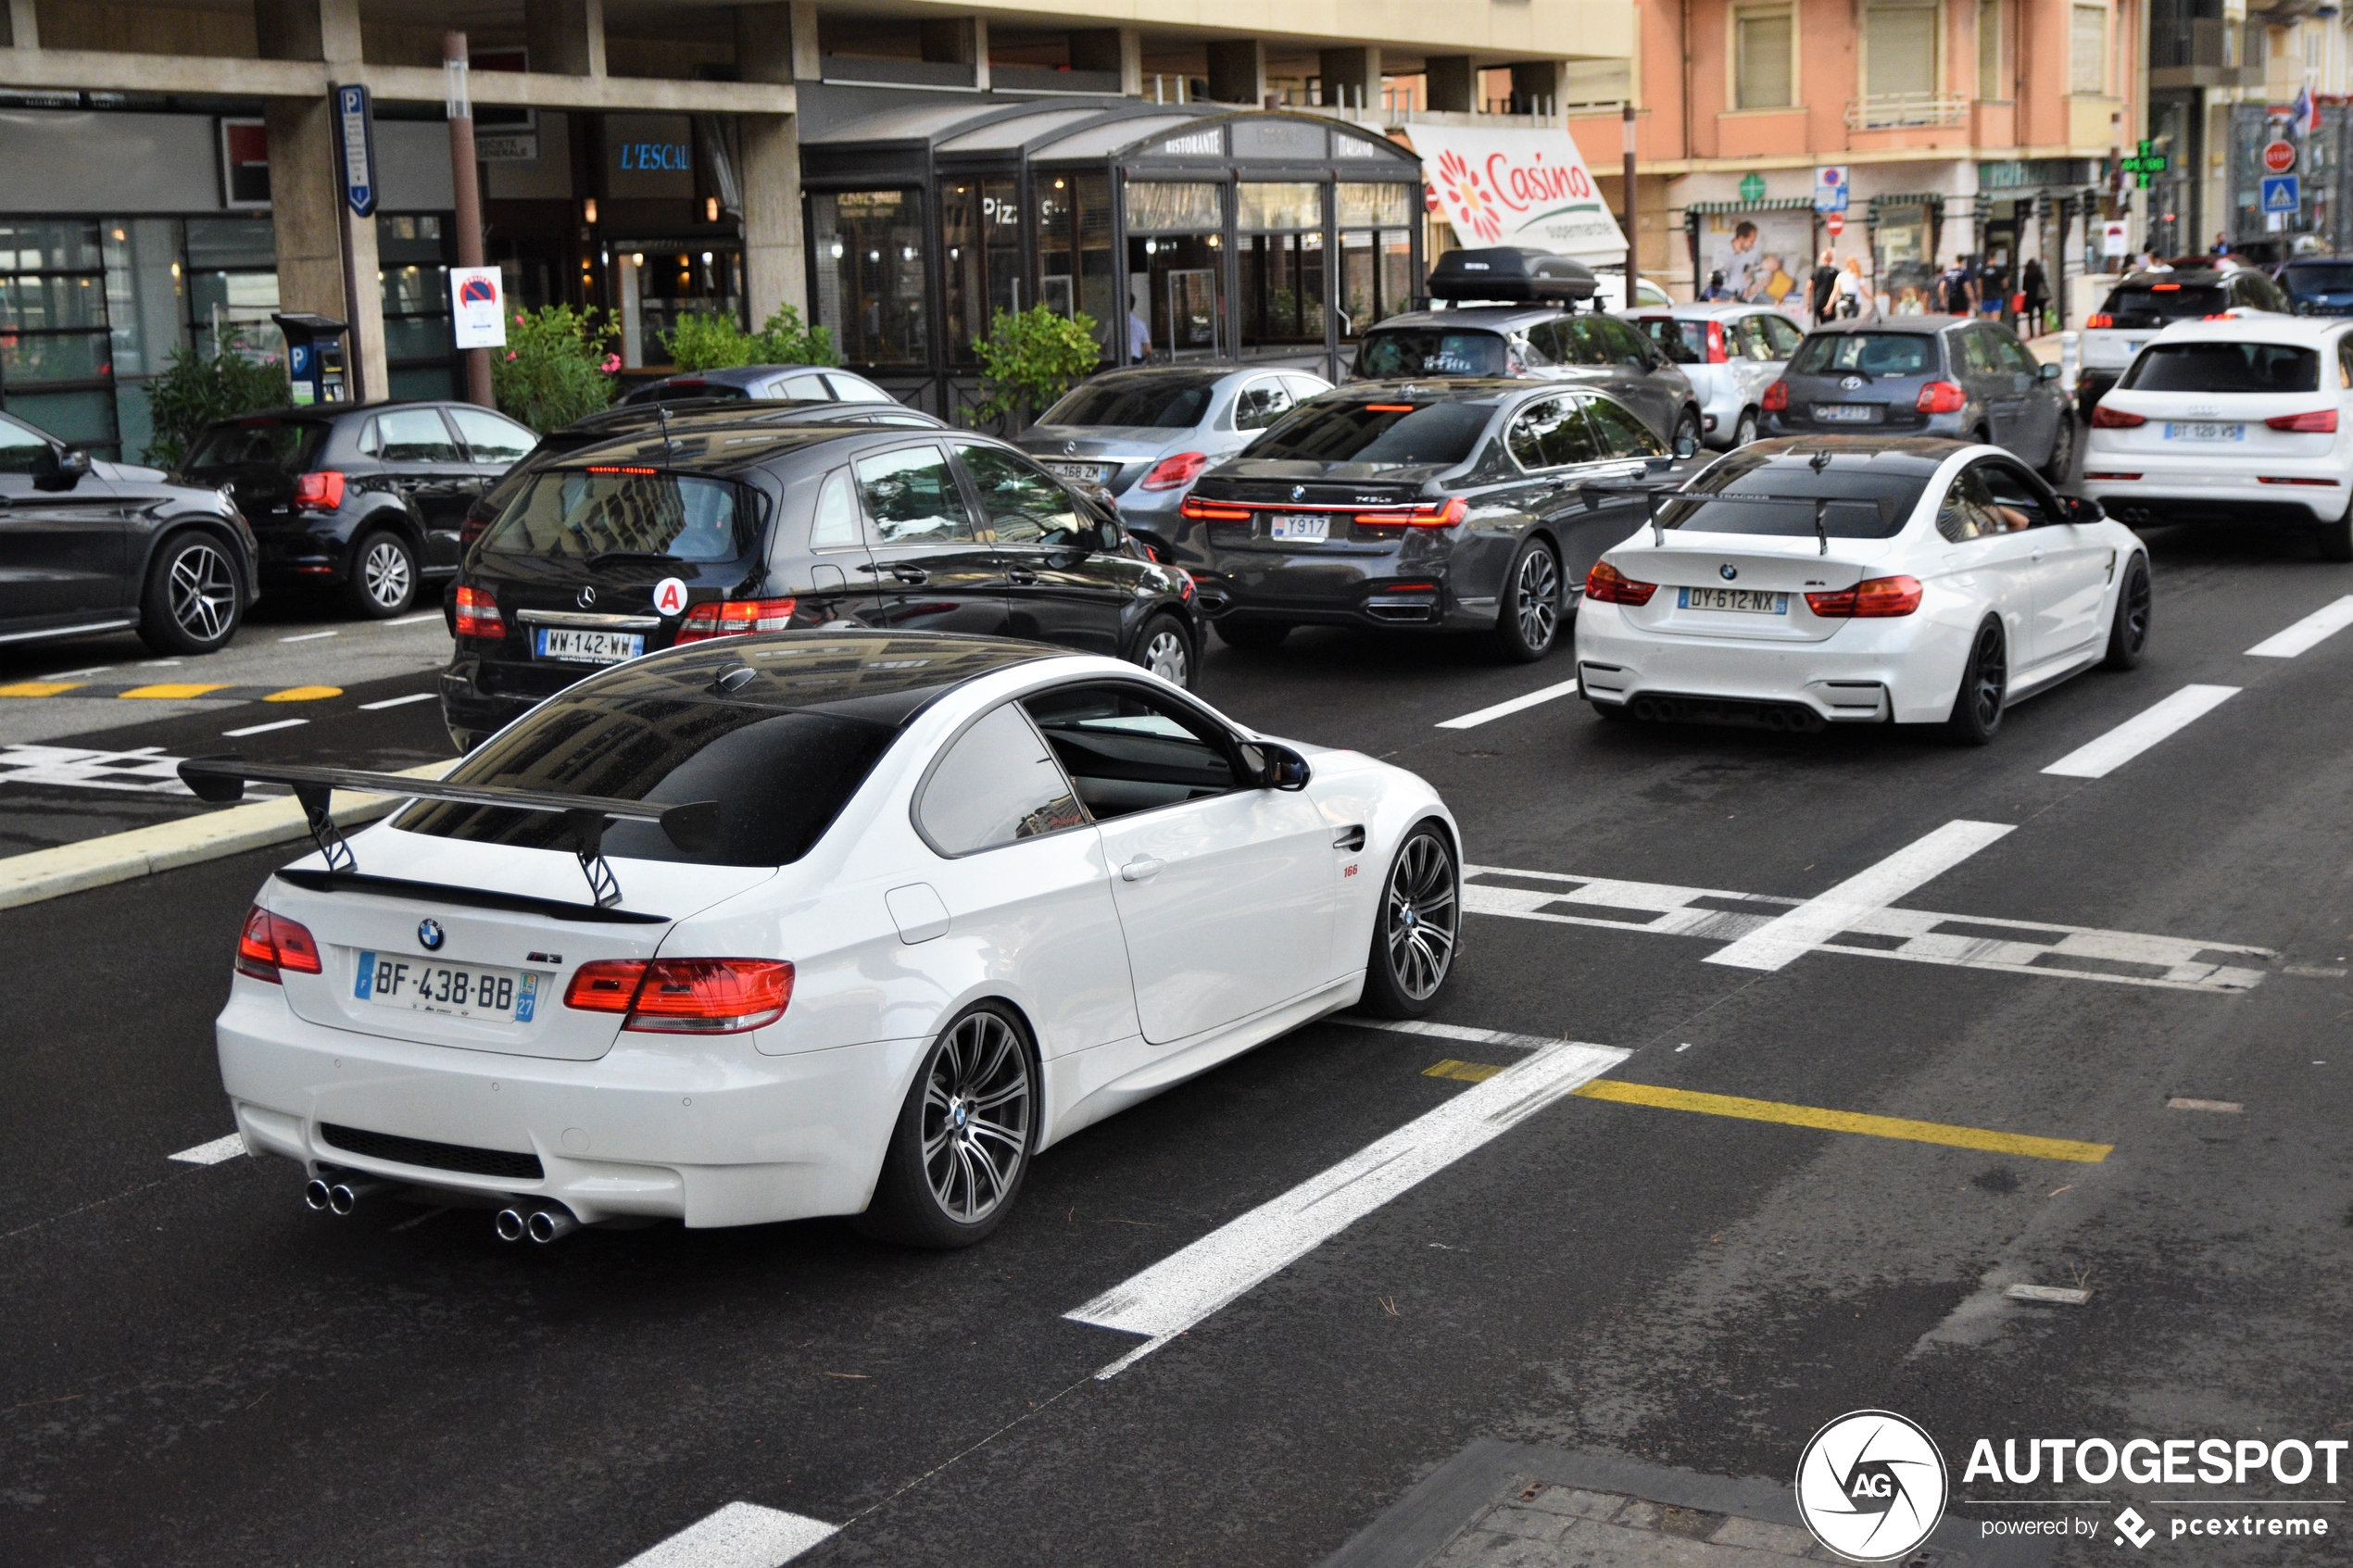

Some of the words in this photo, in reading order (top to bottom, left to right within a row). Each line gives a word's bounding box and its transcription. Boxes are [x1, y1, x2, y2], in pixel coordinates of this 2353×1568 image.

[345, 93, 358, 112] P
[1165, 130, 1219, 154] RISTORANTE
[2266, 150, 2292, 162] STOP
[1487, 151, 1590, 212] Casino
[293, 347, 304, 369] P
[1289, 519, 1326, 533] Y917
[661, 584, 679, 609] A
[526, 951, 562, 964] M3
[376, 961, 513, 1010] BF-438-BB
[517, 998, 534, 1015] 27
